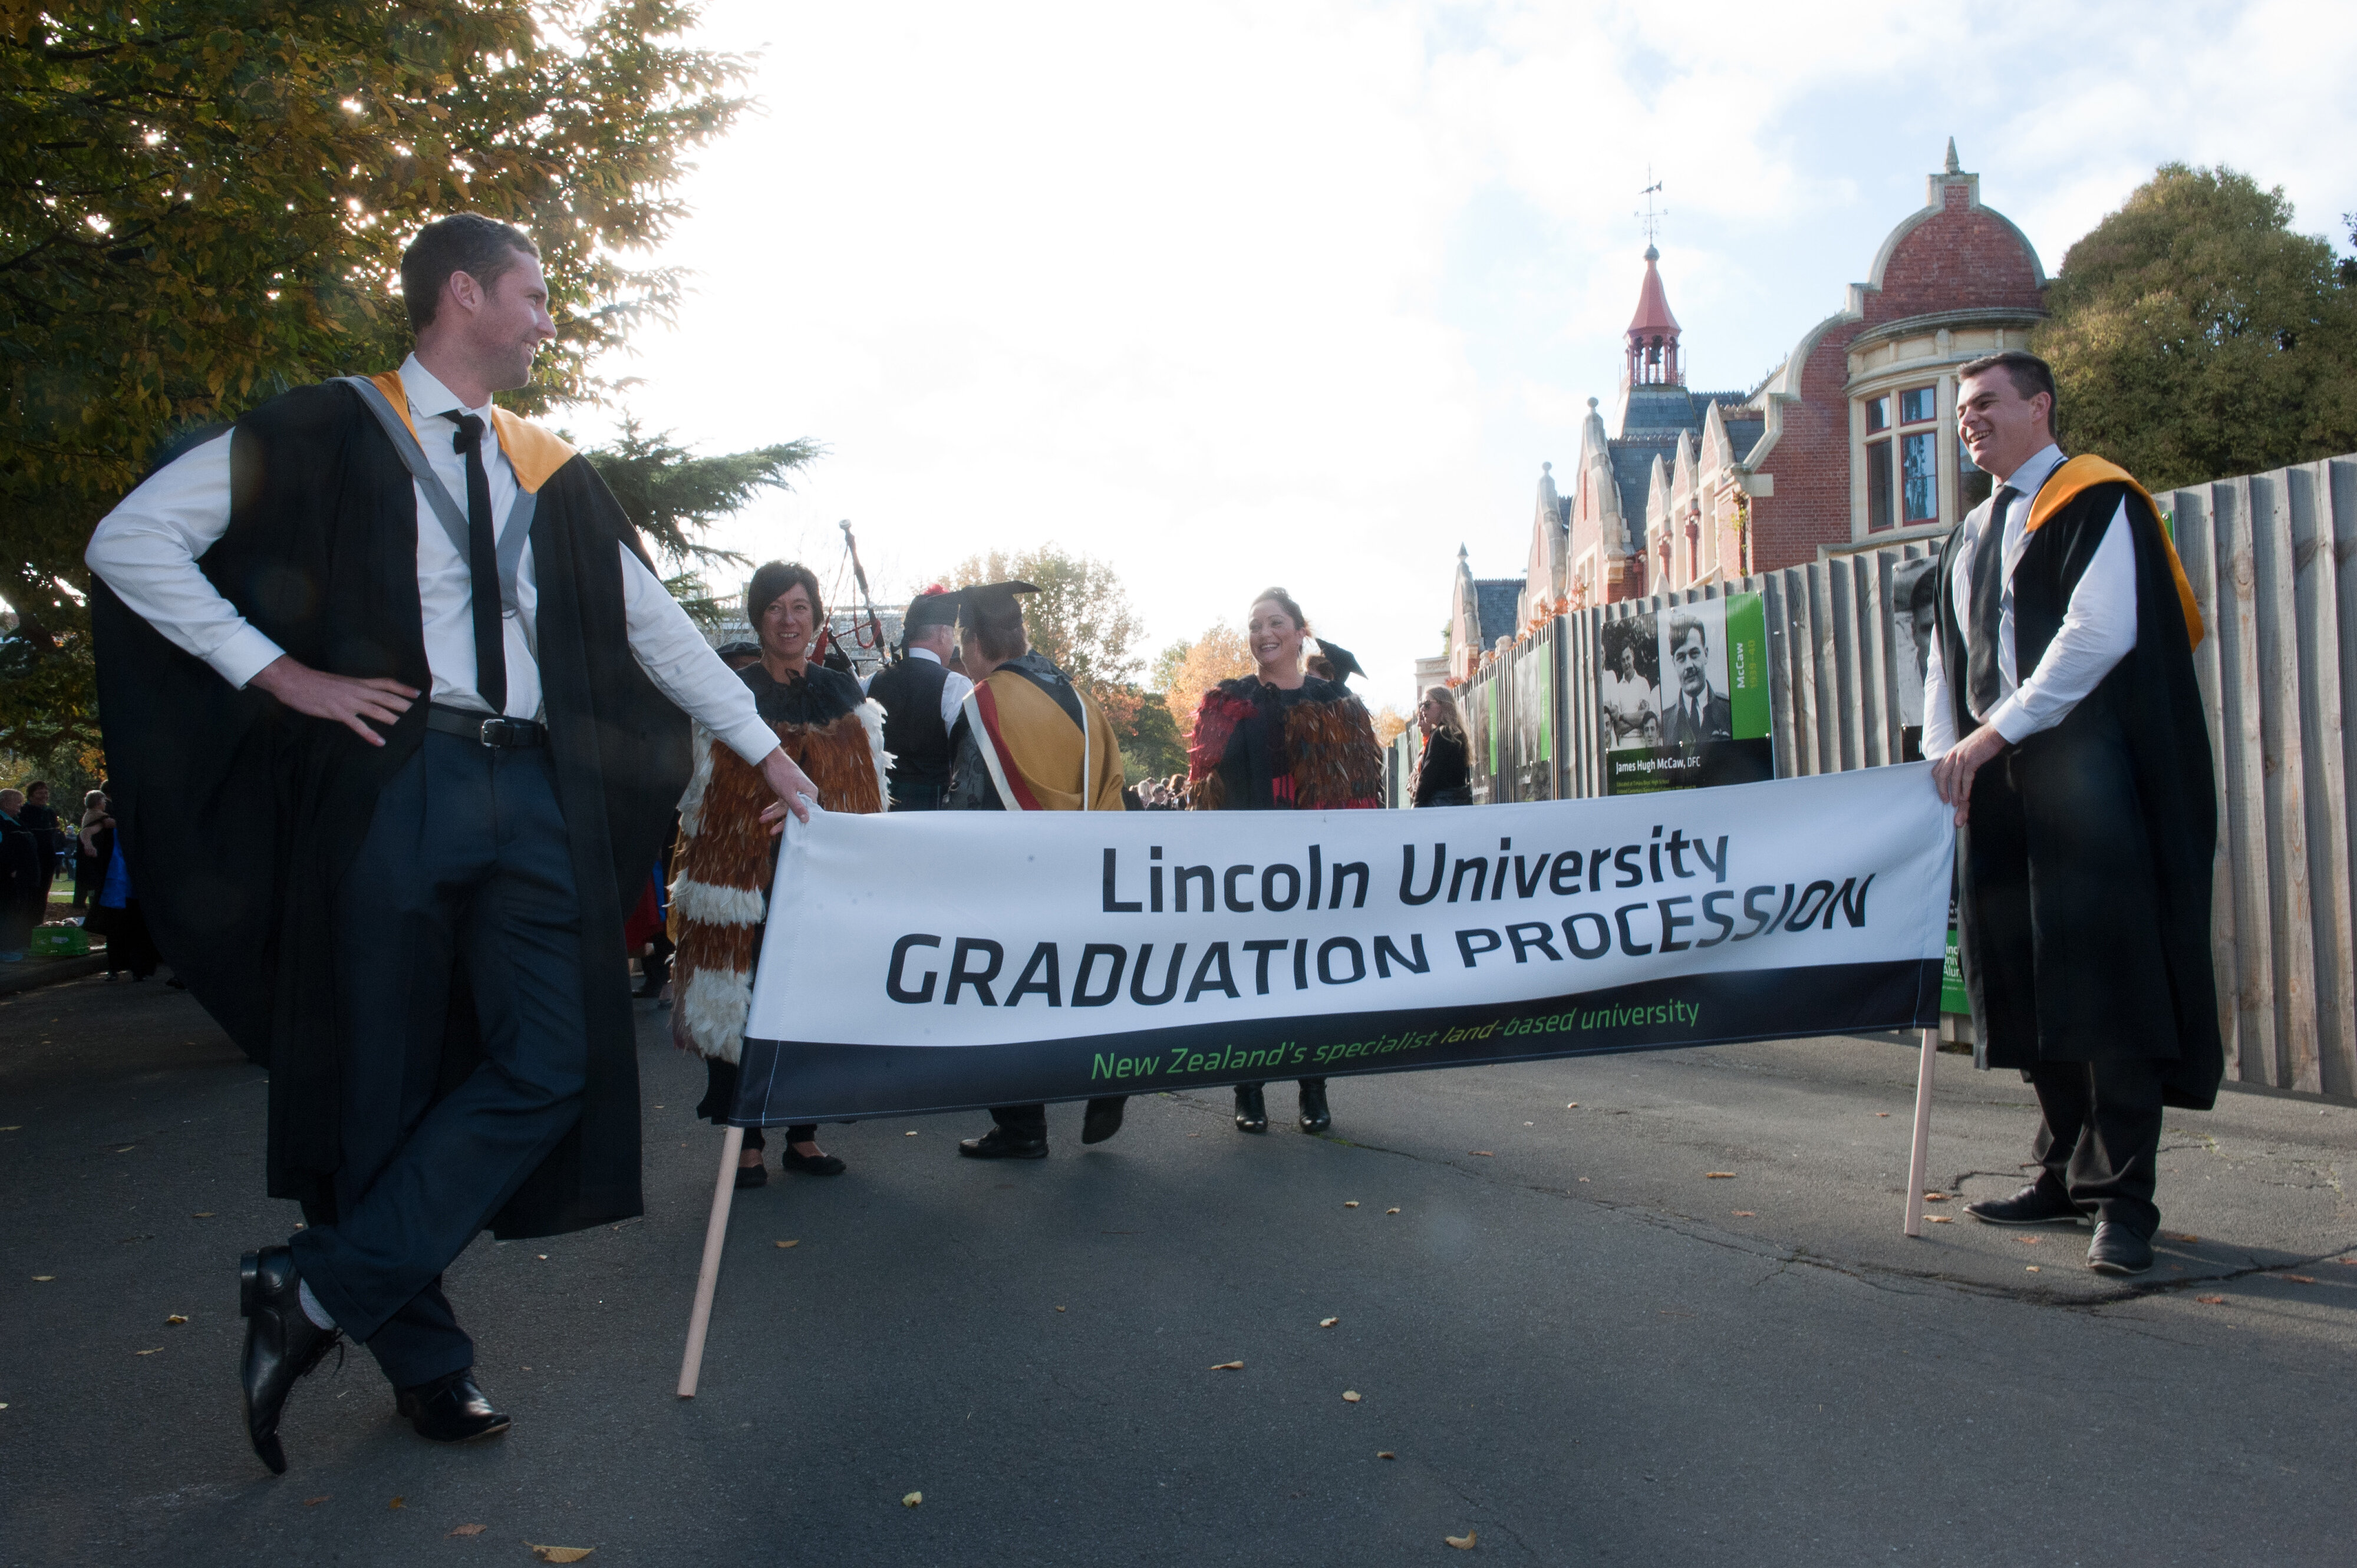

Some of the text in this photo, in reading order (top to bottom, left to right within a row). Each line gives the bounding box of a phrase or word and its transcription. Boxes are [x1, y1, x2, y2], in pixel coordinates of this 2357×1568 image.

[1736, 642, 1745, 688] McCaw
[1616, 756, 1701, 775] James Hugh McCaw, DFC
[1103, 824, 1729, 913] Lincoln University
[886, 873, 1875, 1007] GRADUATION PROCESSION
[1092, 1001, 1699, 1080] New Zealand's specialist land-based university
